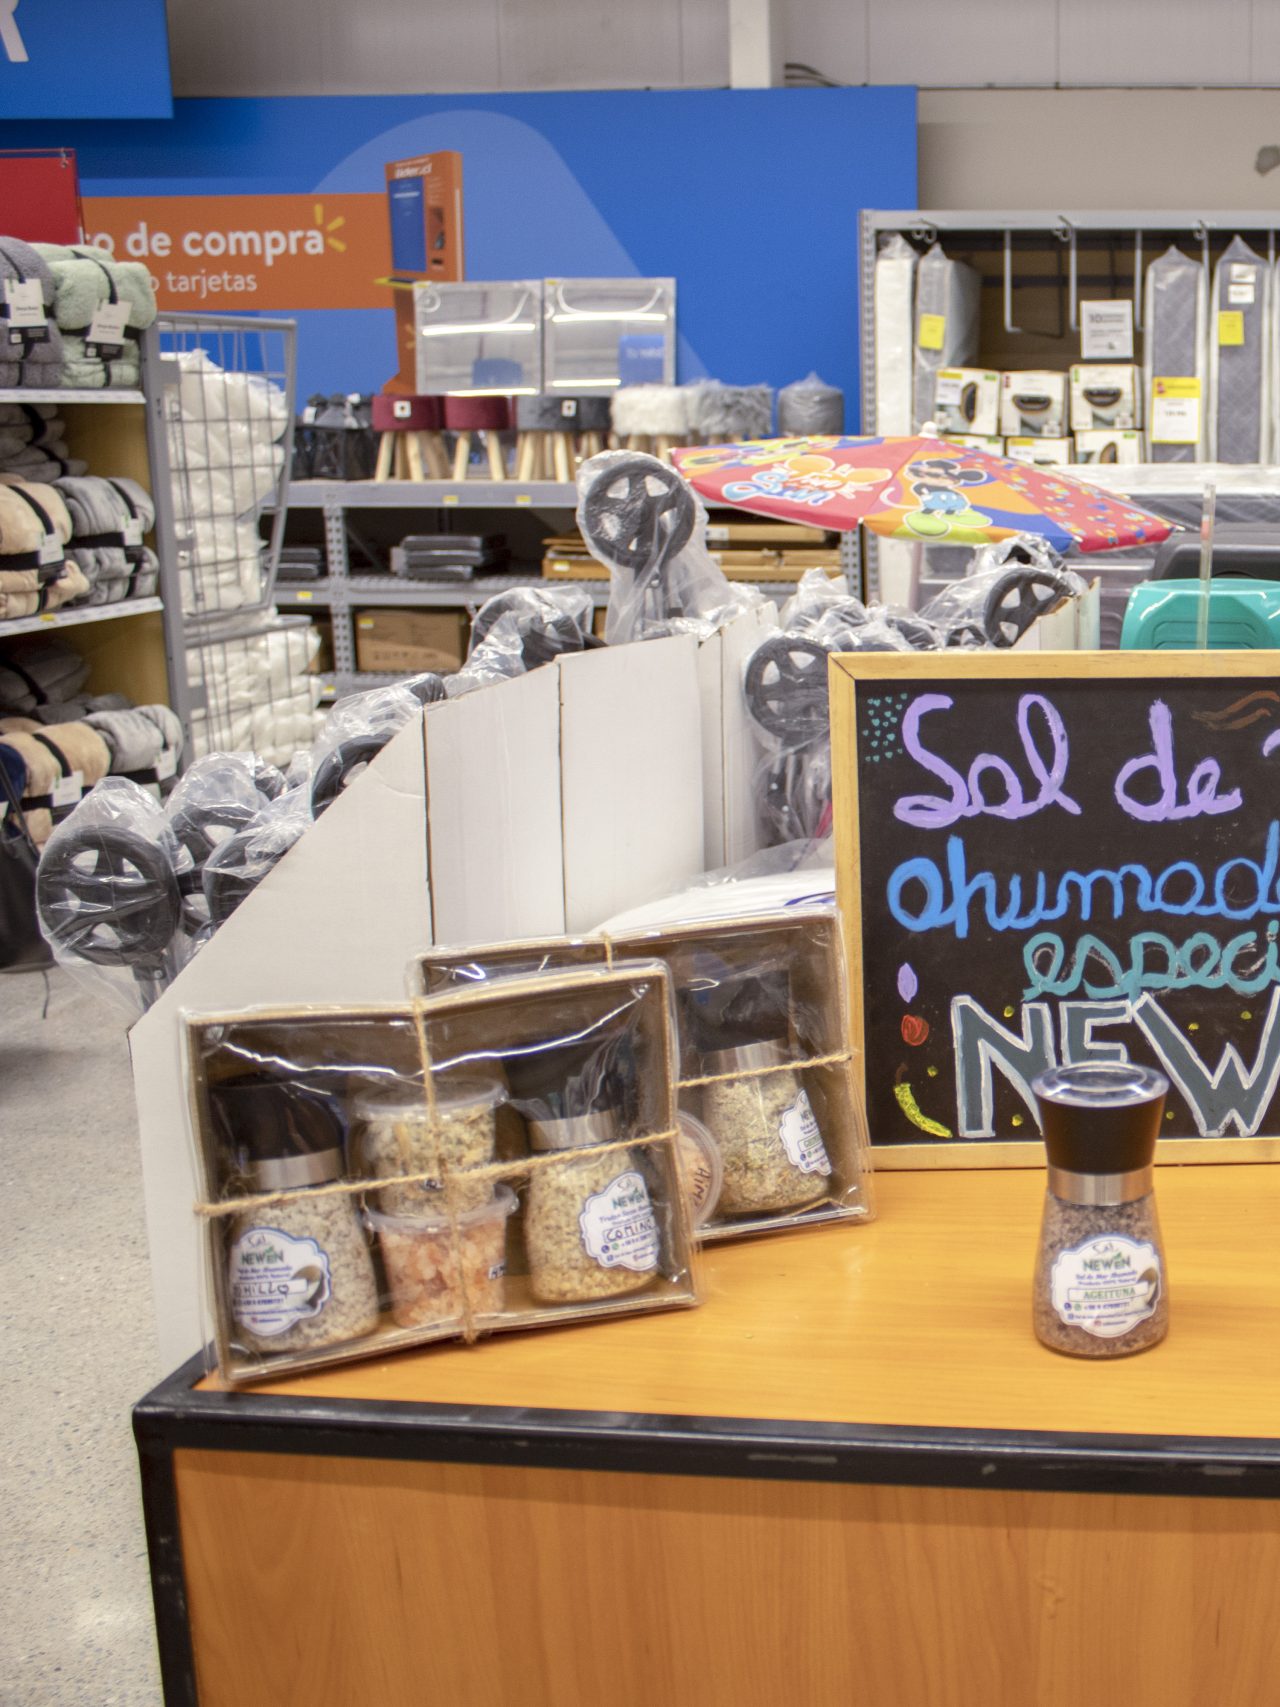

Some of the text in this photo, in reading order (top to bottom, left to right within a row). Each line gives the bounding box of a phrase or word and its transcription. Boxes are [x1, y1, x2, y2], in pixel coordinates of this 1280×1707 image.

[126, 222, 171, 257] de
[182, 229, 325, 267] compra
[167, 270, 258, 298] tarjetas
[893, 693, 1082, 829] Sal
[1114, 698, 1243, 822] de
[1083, 1256, 1131, 1272] NEWEN
